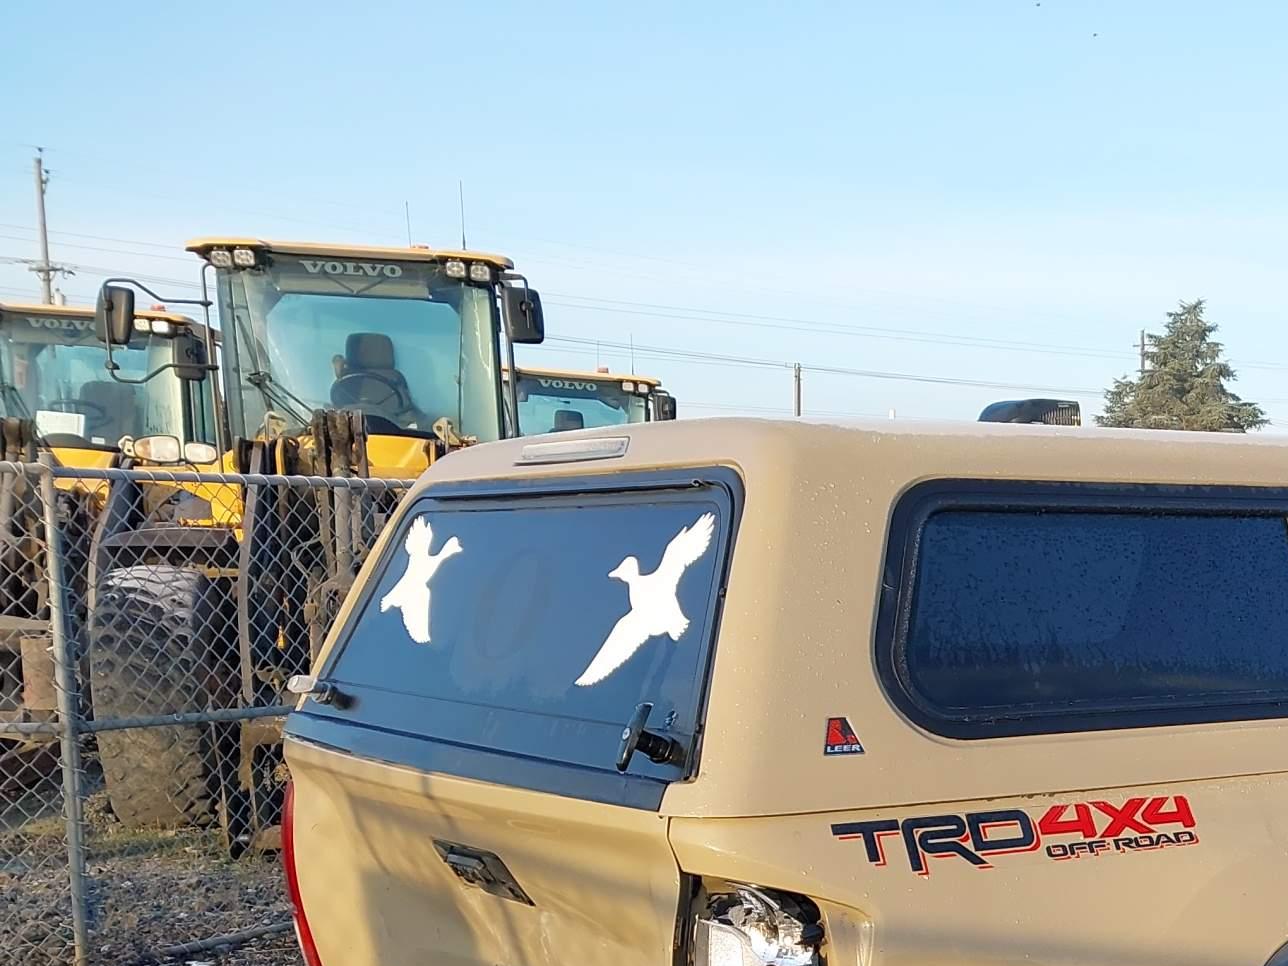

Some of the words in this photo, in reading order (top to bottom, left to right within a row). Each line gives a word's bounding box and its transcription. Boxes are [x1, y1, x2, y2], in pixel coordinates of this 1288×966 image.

[300, 260, 402, 278] VOLVO
[538, 379, 597, 391] VOLVO
[826, 744, 861, 753] LEER
[831, 809, 1041, 876] TRD
[1037, 795, 1197, 839] 4X4
[1046, 841, 1109, 860] OFF
[1115, 831, 1199, 853] ROAD
